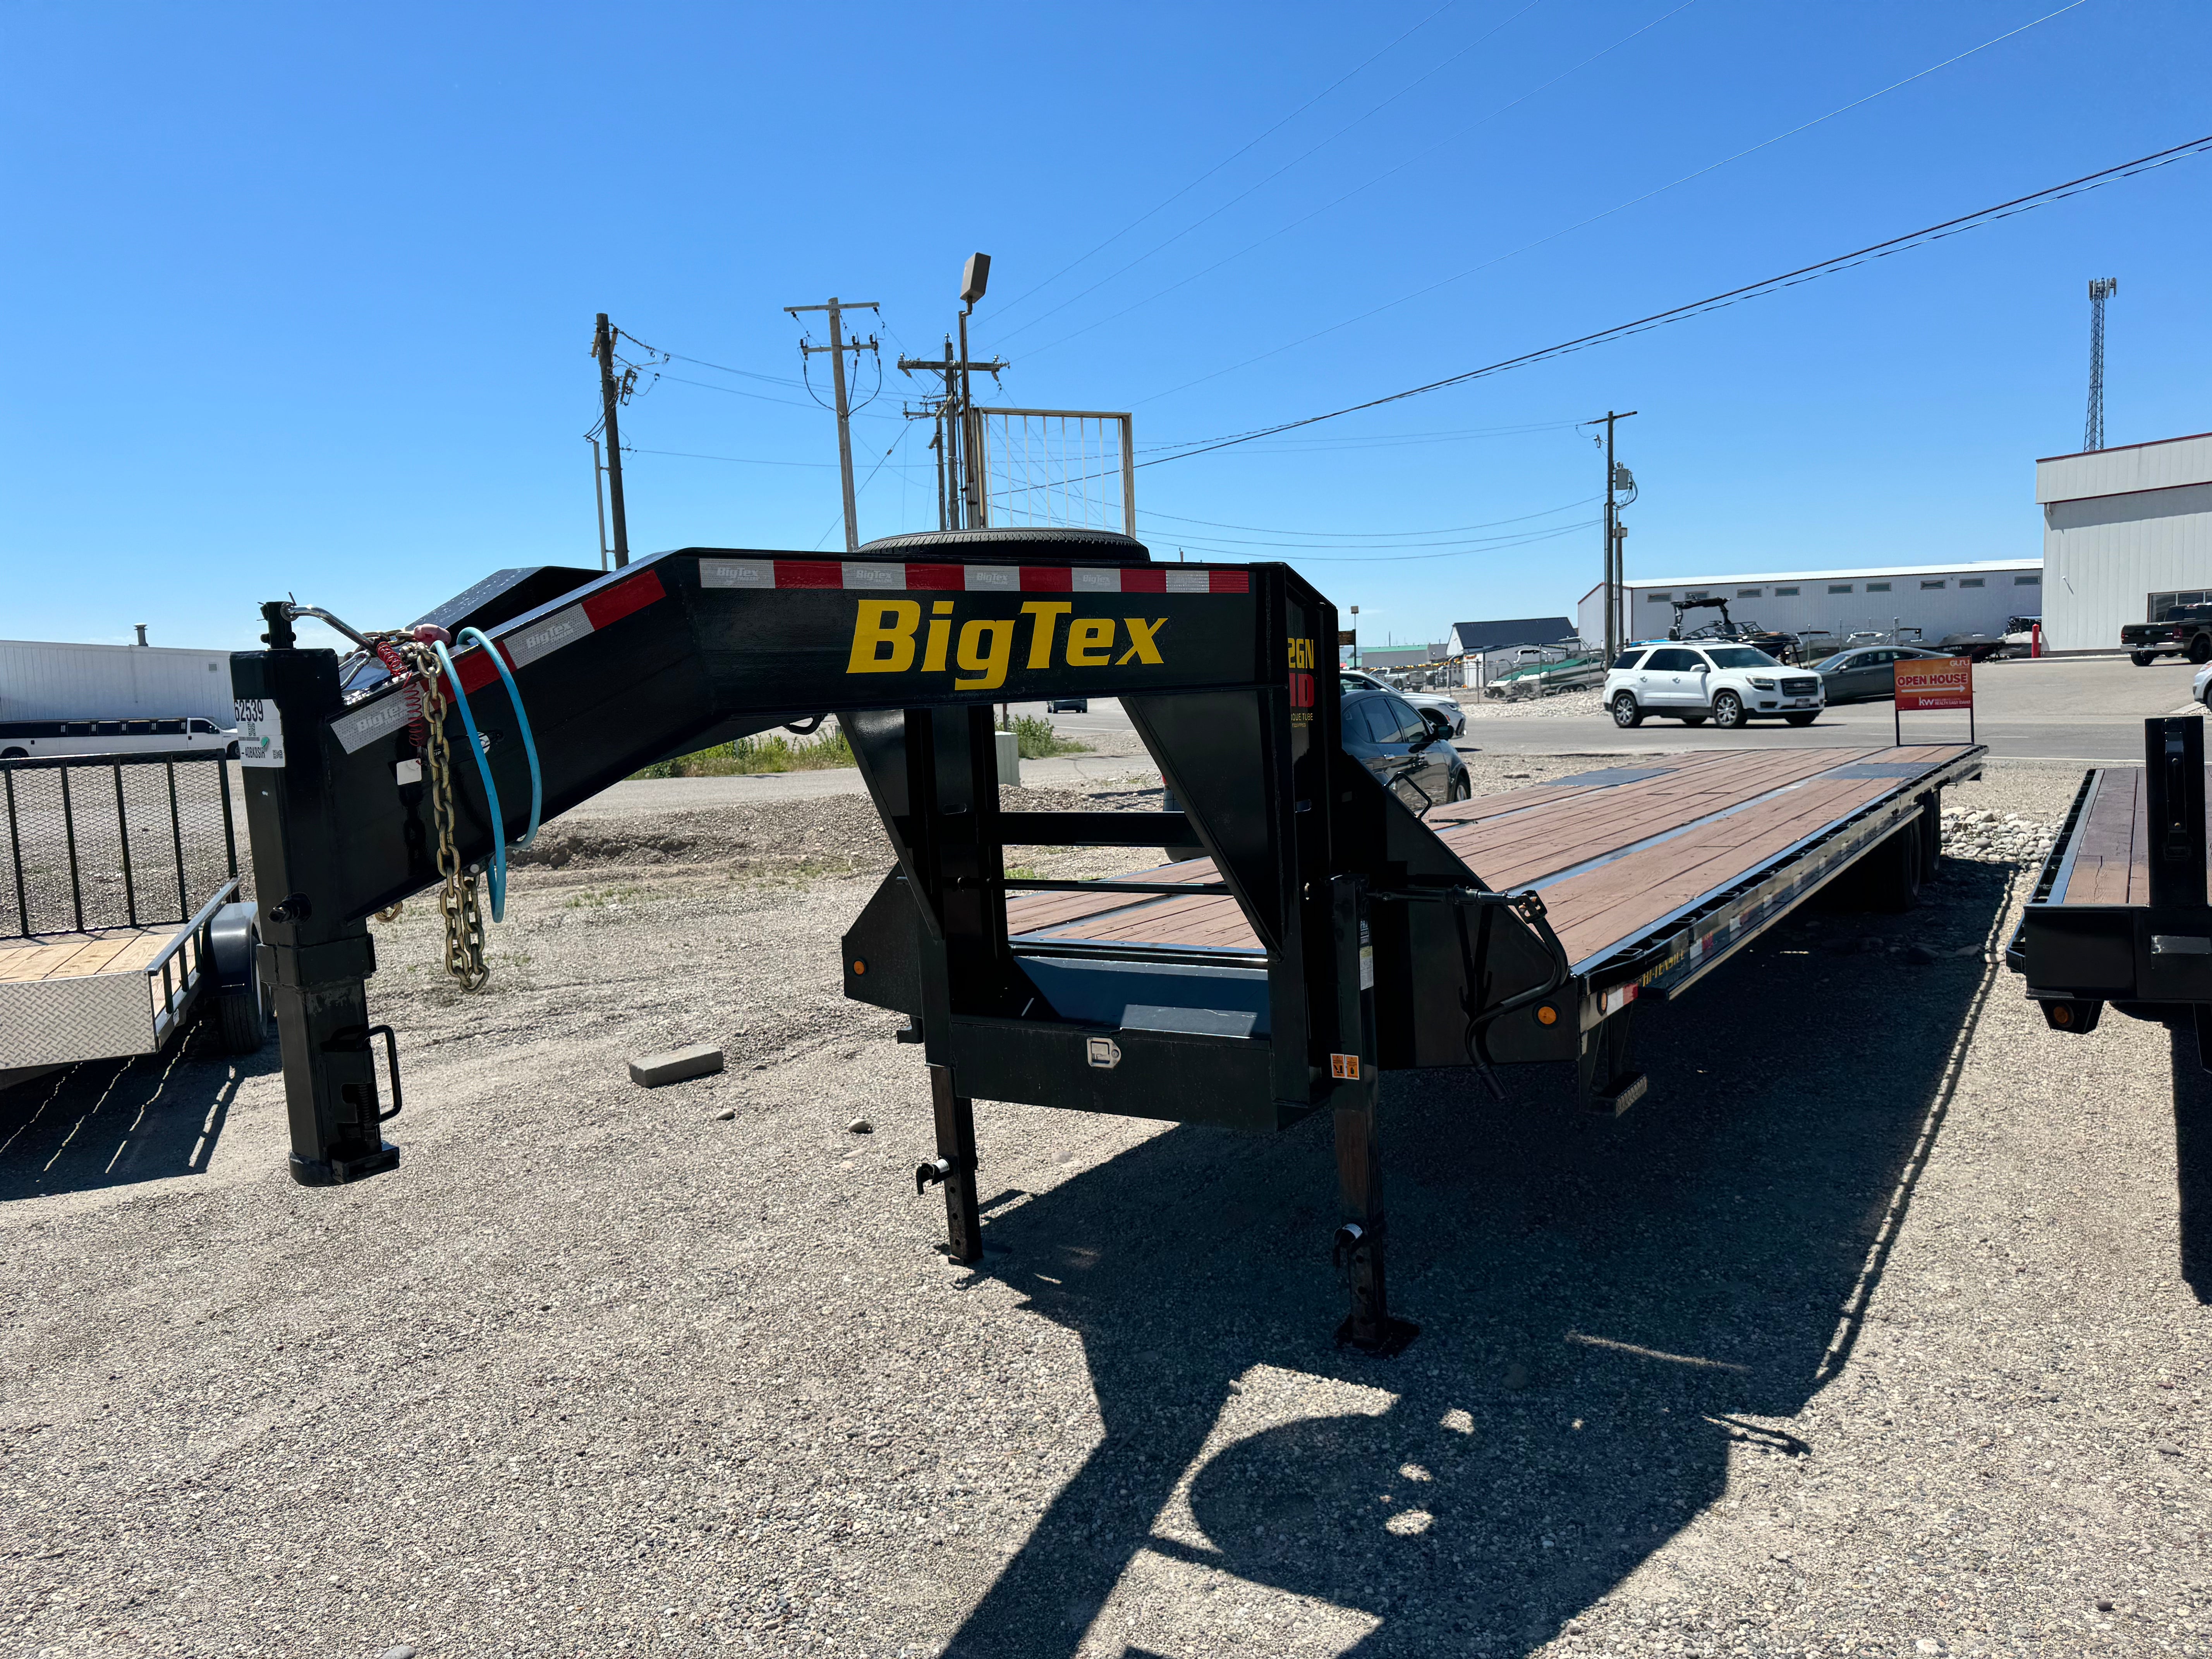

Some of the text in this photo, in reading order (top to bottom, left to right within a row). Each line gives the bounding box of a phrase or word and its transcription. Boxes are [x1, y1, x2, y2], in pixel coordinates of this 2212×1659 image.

[716, 567, 758, 580] BigTex
[855, 570, 891, 581] BigTex
[976, 572, 1008, 583] BigTex
[526, 621, 572, 648] BigTex
[846, 599, 1168, 690] BigTex
[1897, 673, 1968, 687] OPEN HOUSE
[1919, 697, 1934, 706] kw
[234, 699, 263, 722] 62539
